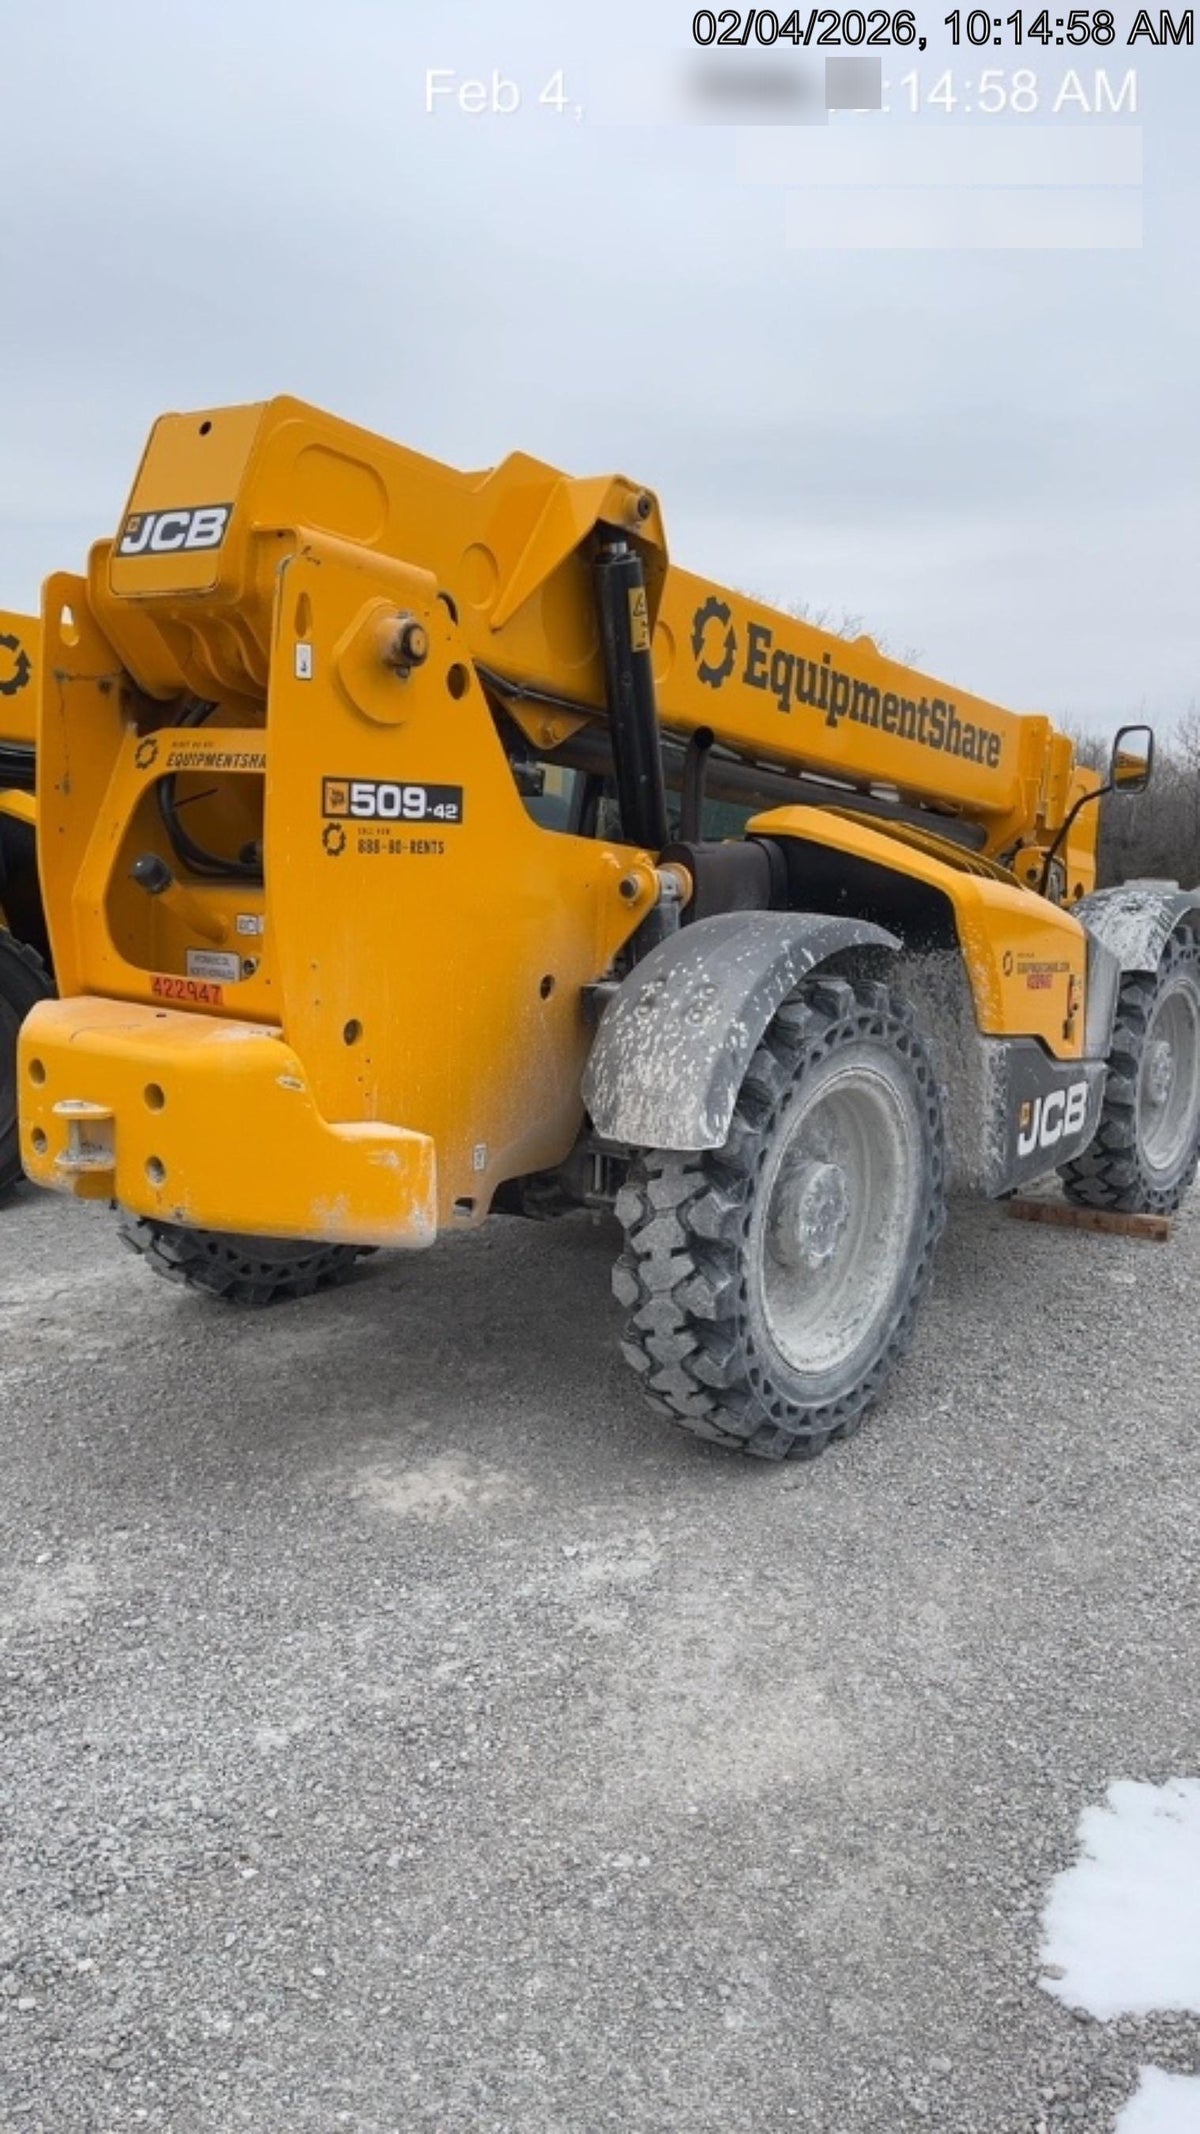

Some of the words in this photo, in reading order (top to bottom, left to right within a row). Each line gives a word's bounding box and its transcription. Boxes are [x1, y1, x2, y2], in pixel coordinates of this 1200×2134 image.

[120, 507, 229, 554] JCB
[742, 621, 1003, 769] EquipmentShare
[153, 977, 222, 1006] 422947
[1017, 1081, 1088, 1155] JCB
